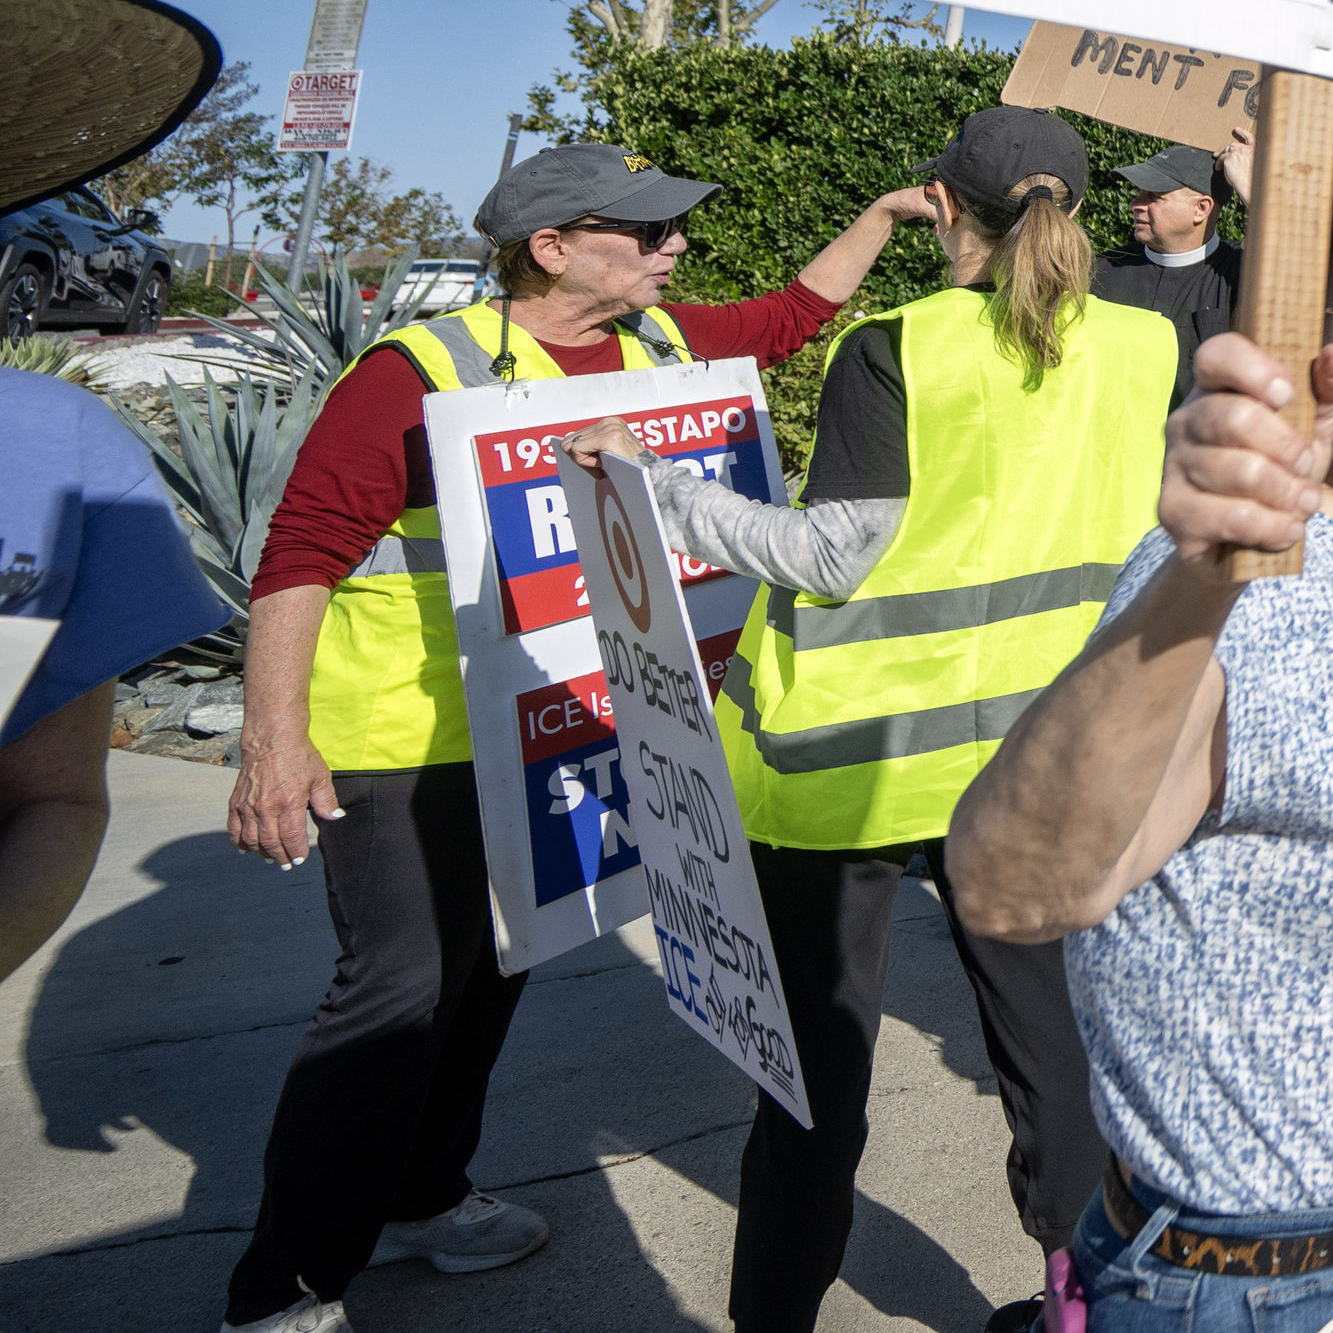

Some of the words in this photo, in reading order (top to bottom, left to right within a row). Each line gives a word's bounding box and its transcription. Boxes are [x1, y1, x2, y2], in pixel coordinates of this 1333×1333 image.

[305, 74, 356, 90] TARGET
[1071, 29, 1204, 90] MENT
[626, 407, 746, 453] ESTAPO
[528, 696, 584, 740] ICE
[598, 629, 635, 693] DO
[633, 642, 713, 743] BETTER
[639, 740, 729, 863] STAND
[675, 842, 721, 911] WITH
[644, 863, 780, 1009] MINNESOTA
[654, 924, 709, 1026] ICE
